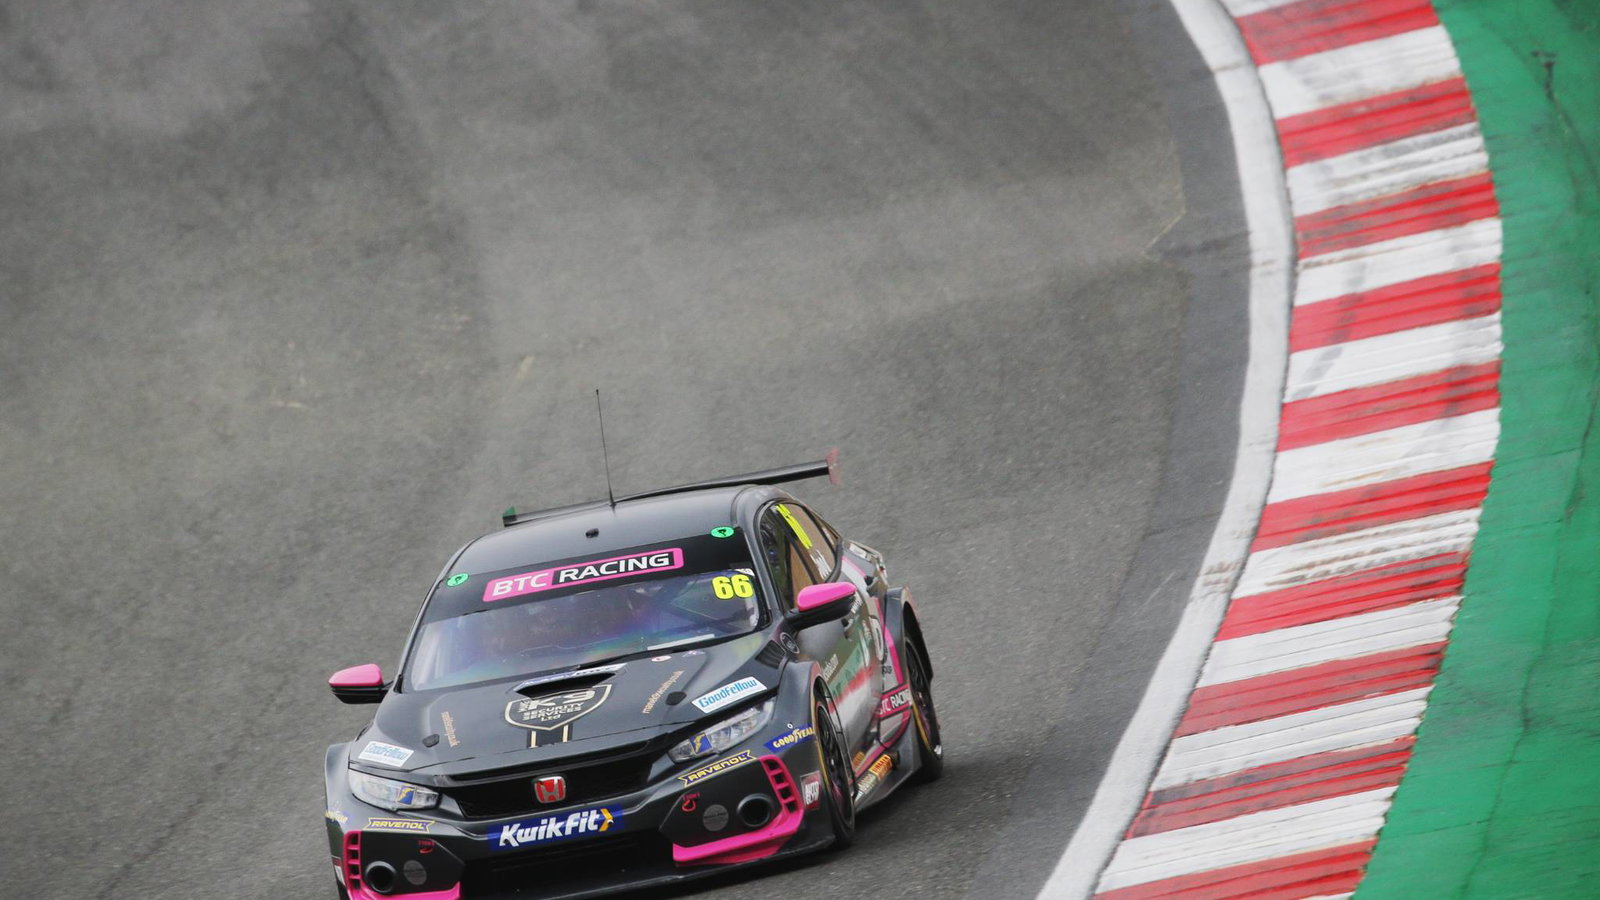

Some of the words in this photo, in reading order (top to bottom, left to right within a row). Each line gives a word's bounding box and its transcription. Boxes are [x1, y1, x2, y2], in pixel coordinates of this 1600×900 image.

[492, 571, 549, 597] BTC
[558, 552, 671, 584] RACING
[712, 574, 754, 600] 66
[687, 752, 748, 781] RAVENOL
[371, 820, 425, 830] RAVENOL
